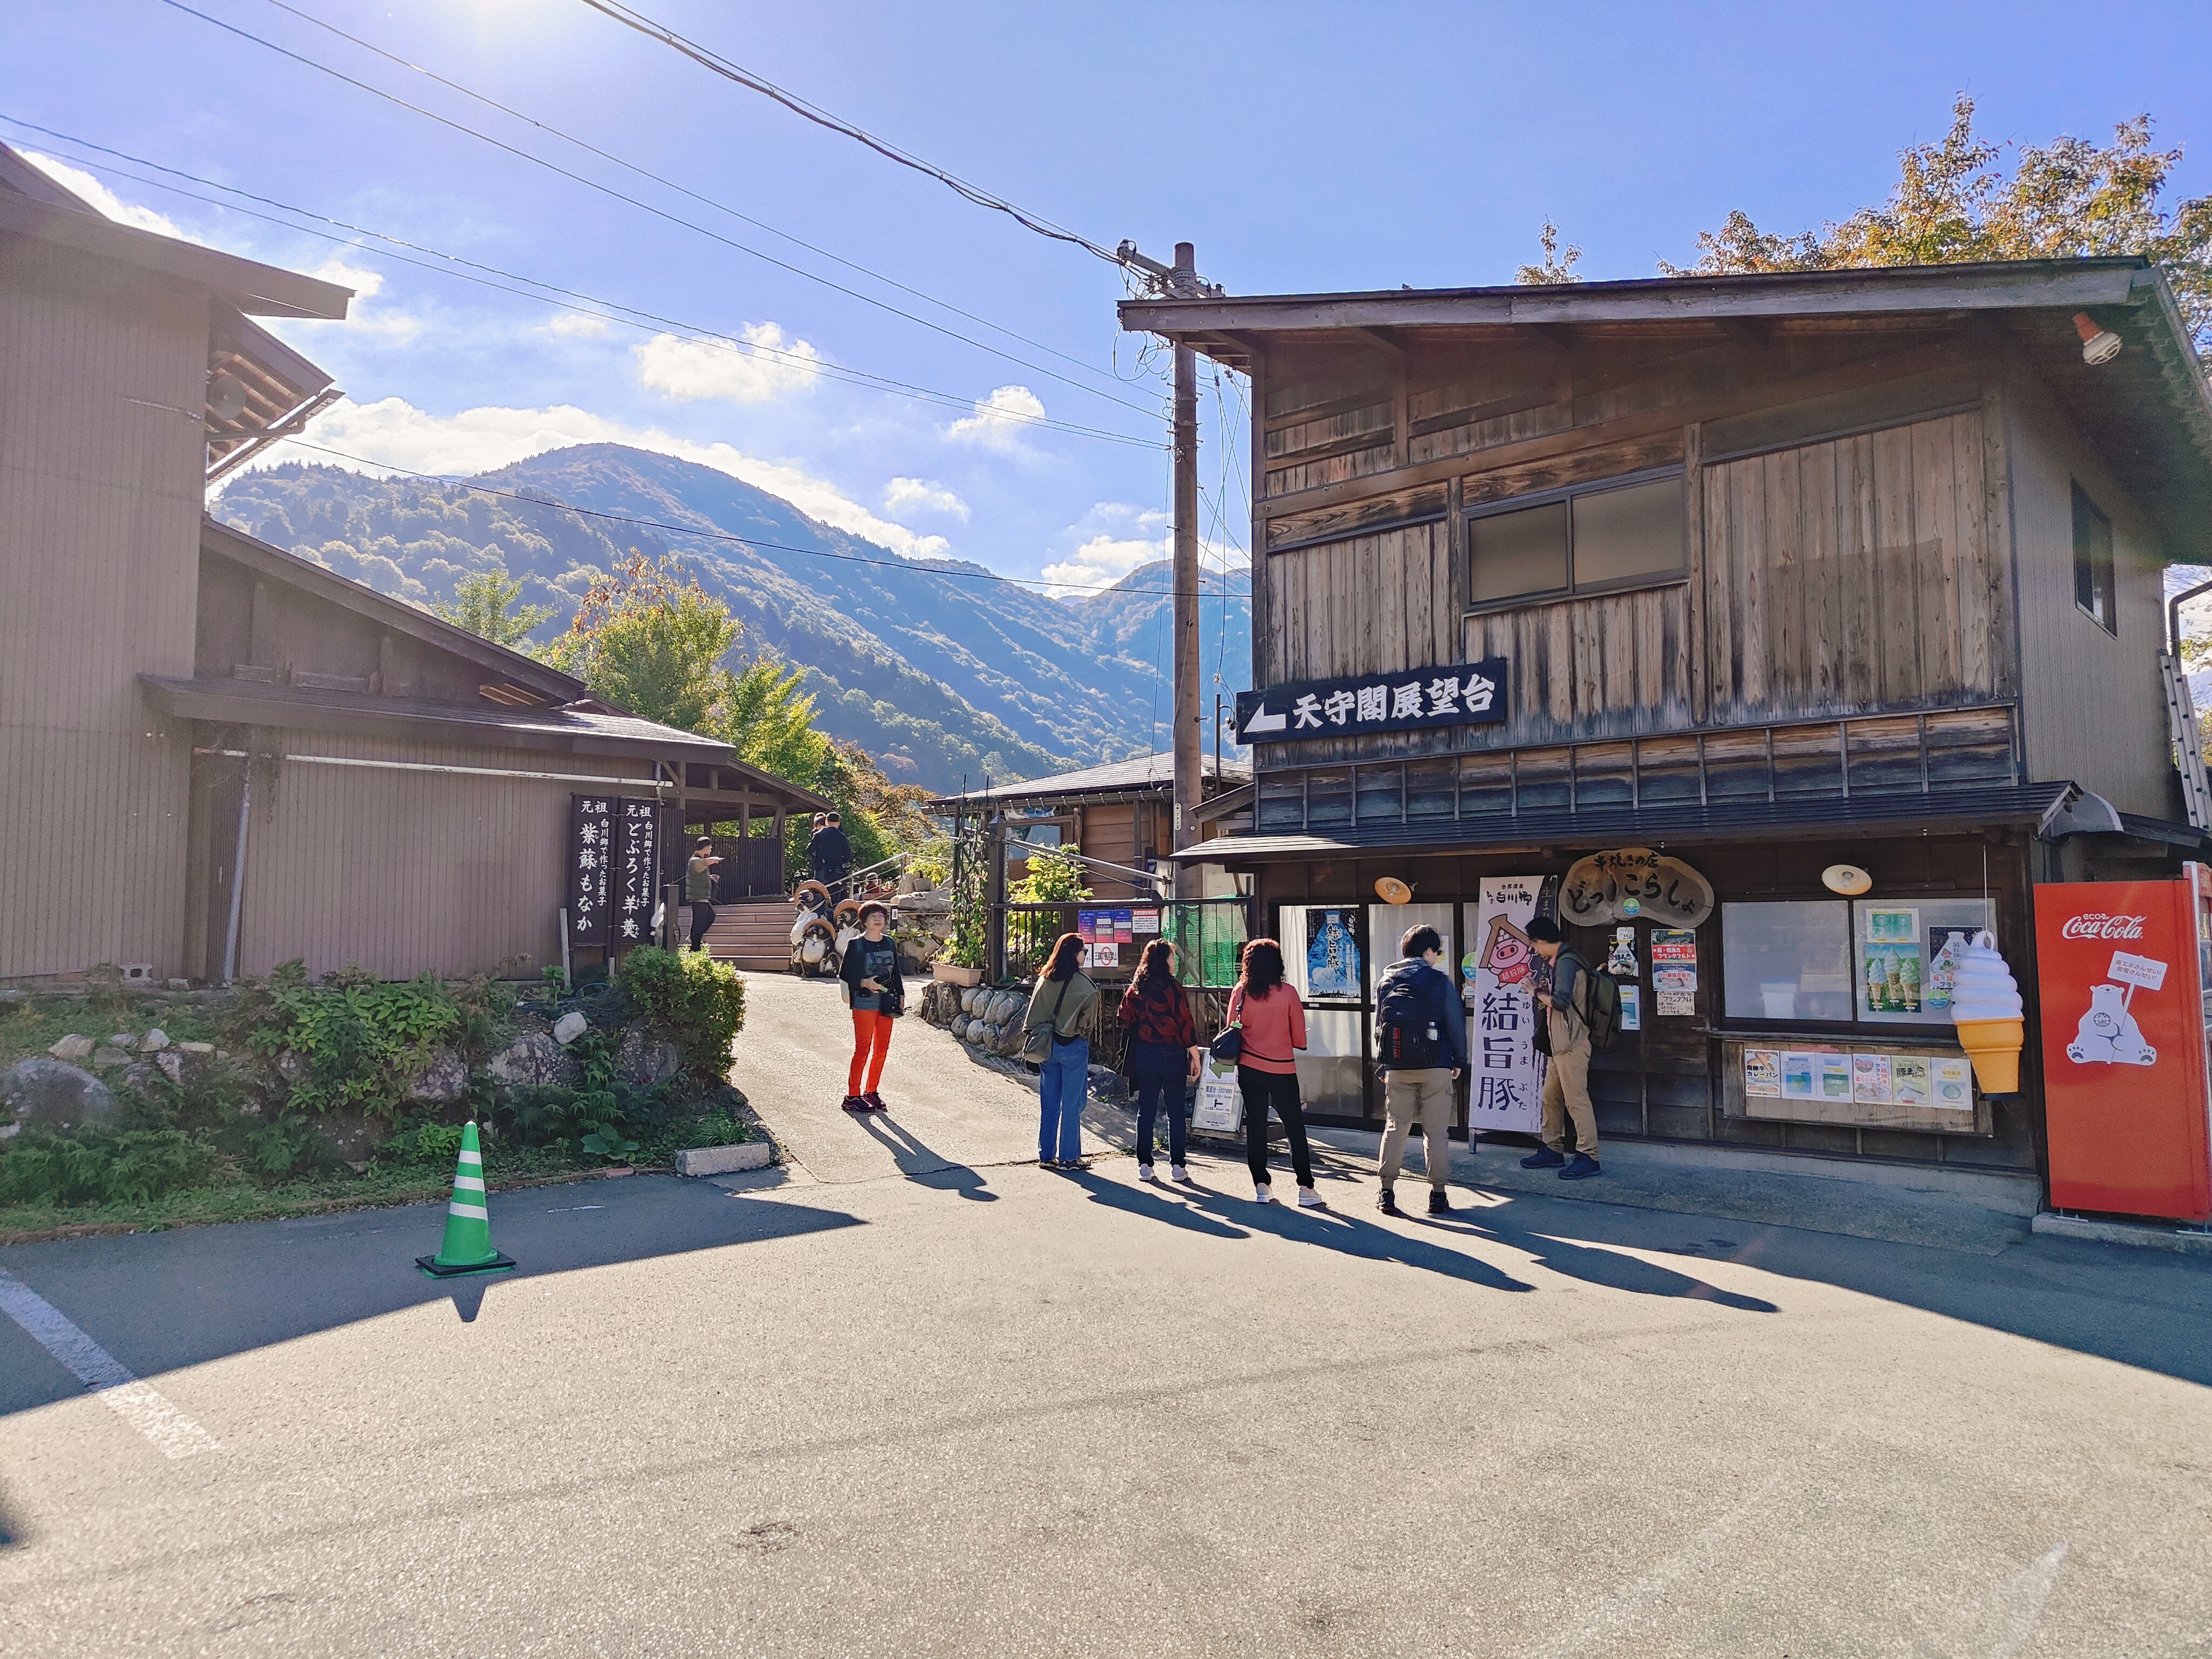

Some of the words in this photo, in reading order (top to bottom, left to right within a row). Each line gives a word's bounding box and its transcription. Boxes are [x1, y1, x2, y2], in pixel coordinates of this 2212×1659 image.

[1292, 673, 1495, 729] 天守閣展望台
[581, 800, 608, 814] 元祖
[626, 805, 652, 818] 元祖
[597, 818, 609, 906] 白川郷で作ったお菓子
[640, 821, 653, 907] 白川郷で作ったお菓子
[1594, 852, 1658, 872] 串焼きの店
[577, 822, 599, 931] 紫蘇もなか
[1496, 891, 1533, 906] 白川郷
[1567, 873, 1695, 914] どっこらしょ
[2062, 915, 2148, 940] Coca-Cola
[1501, 965, 1526, 981] 結旨豚
[1522, 1001, 1530, 1024] ゆい
[1478, 992, 1521, 1111] 結旨豚
[1520, 1041, 1528, 1065] うま
